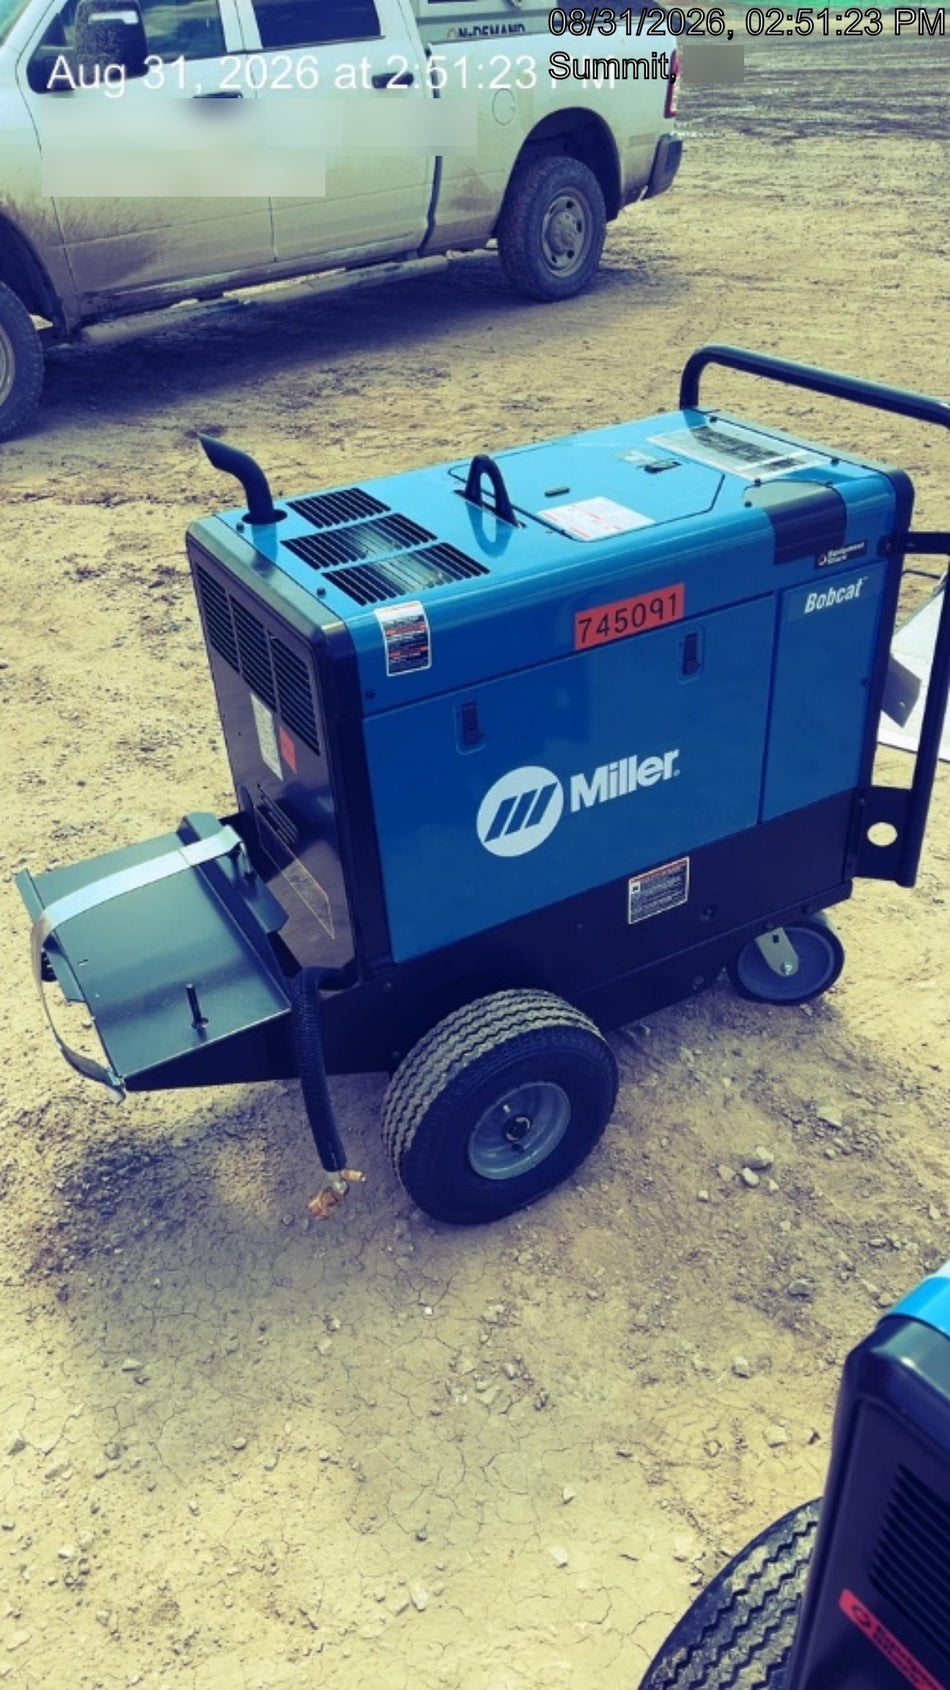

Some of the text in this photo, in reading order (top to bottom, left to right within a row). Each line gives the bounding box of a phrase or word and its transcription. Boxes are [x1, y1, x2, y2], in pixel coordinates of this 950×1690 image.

[577, 593, 677, 643] 745091
[803, 577, 864, 614] Bobcat
[569, 749, 679, 813] Miller
